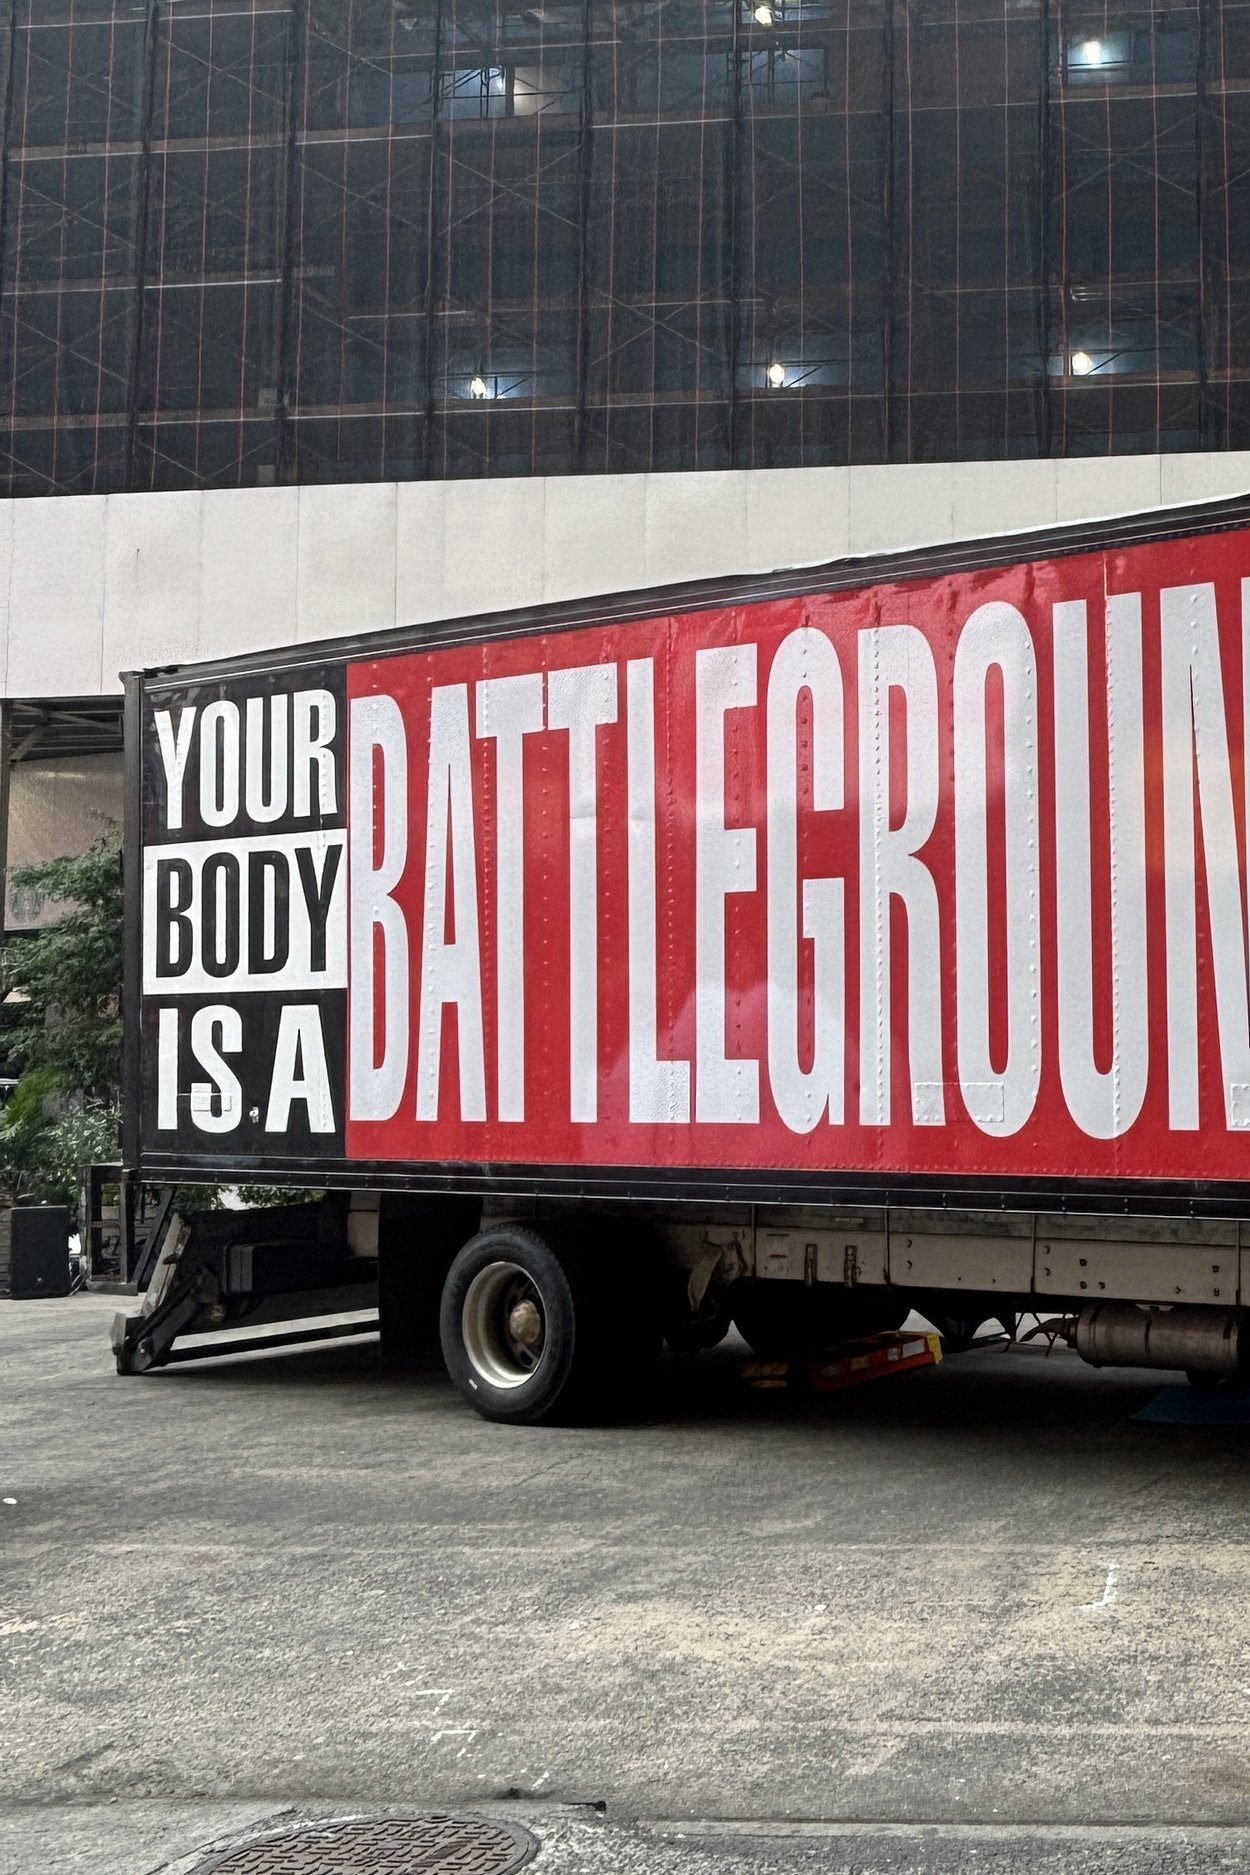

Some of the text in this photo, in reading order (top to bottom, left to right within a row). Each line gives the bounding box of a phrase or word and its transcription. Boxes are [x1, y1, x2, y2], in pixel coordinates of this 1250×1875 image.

[155, 688, 339, 829] YOUR
[156, 844, 344, 979] BODY
[158, 1004, 336, 1133] IS A
